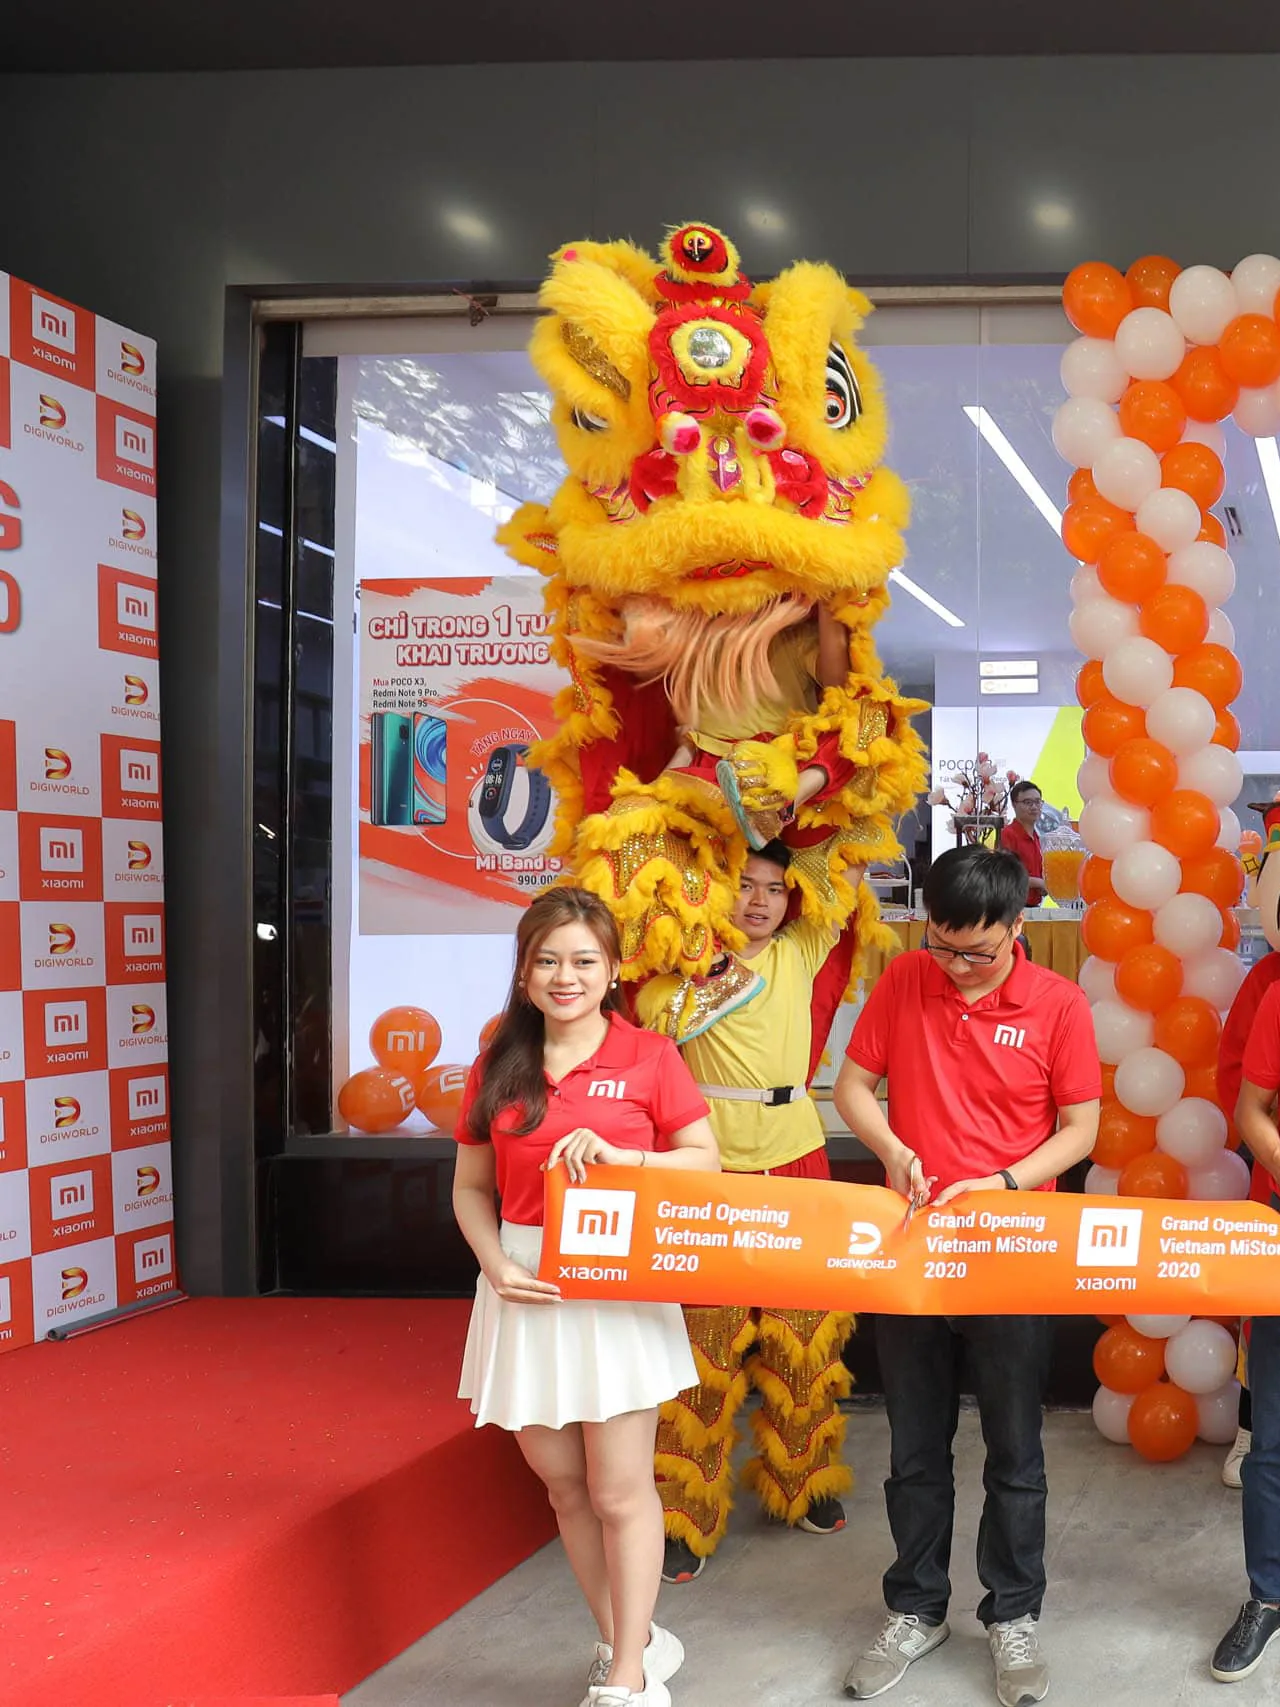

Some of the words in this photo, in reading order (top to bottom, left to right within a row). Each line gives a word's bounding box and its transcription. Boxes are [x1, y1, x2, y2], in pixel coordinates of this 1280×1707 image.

[32, 346, 76, 371] xiaomi
[24, 424, 85, 453] DIGIWORLD
[115, 464, 154, 485] xiaomi
[108, 538, 157, 559] DIGIWORL
[412, 615, 489, 639] TRONG
[492, 605, 511, 637] 1
[118, 631, 157, 647] xiaomi
[397, 644, 451, 667] KHAI
[373, 679, 389, 687] Mua
[391, 678, 413, 686] POCO
[414, 678, 427, 687] X3,
[373, 689, 396, 698] Redmi
[398, 688, 416, 697] Note
[418, 689, 423, 697] 9
[373, 700, 396, 709] Redmi
[398, 700, 416, 708] Note
[30, 781, 90, 796] DIGIWORLD
[121, 797, 160, 810] xiaomi
[476, 854, 497, 872] Mi
[501, 852, 546, 872] Band
[548, 856, 563, 872] 5
[42, 878, 84, 890] xiaomi
[34, 957, 94, 969] DIGIWORLD
[125, 961, 163, 972] xiaomi
[47, 1050, 89, 1063] xiaomi
[40, 1126, 99, 1144] DIGIWORLD
[130, 1122, 167, 1136] xiaomi
[657, 1201, 712, 1220] Grand
[716, 1204, 790, 1229] Opening
[927, 1211, 976, 1229] Grand
[979, 1212, 1046, 1233] Opening
[52, 1219, 95, 1237] xiaomi
[1160, 1215, 1209, 1232] Grand
[1213, 1217, 1279, 1237] Opening
[654, 1226, 729, 1248] Vietnam
[732, 1229, 803, 1251] MiStore
[926, 1235, 992, 1254] Vietnam
[995, 1236, 1058, 1253] MiStore
[1159, 1237, 1227, 1255] Vietnam
[651, 1253, 699, 1272] 2020
[826, 1258, 897, 1270] DIGIWORLD
[923, 1260, 967, 1279] 2020
[1157, 1261, 1201, 1279] 2020
[558, 1265, 628, 1281] xiaomi
[135, 1280, 173, 1299] xiaomi
[1075, 1277, 1137, 1291] xiaomi
[46, 1293, 105, 1317] DIGIWORLD
